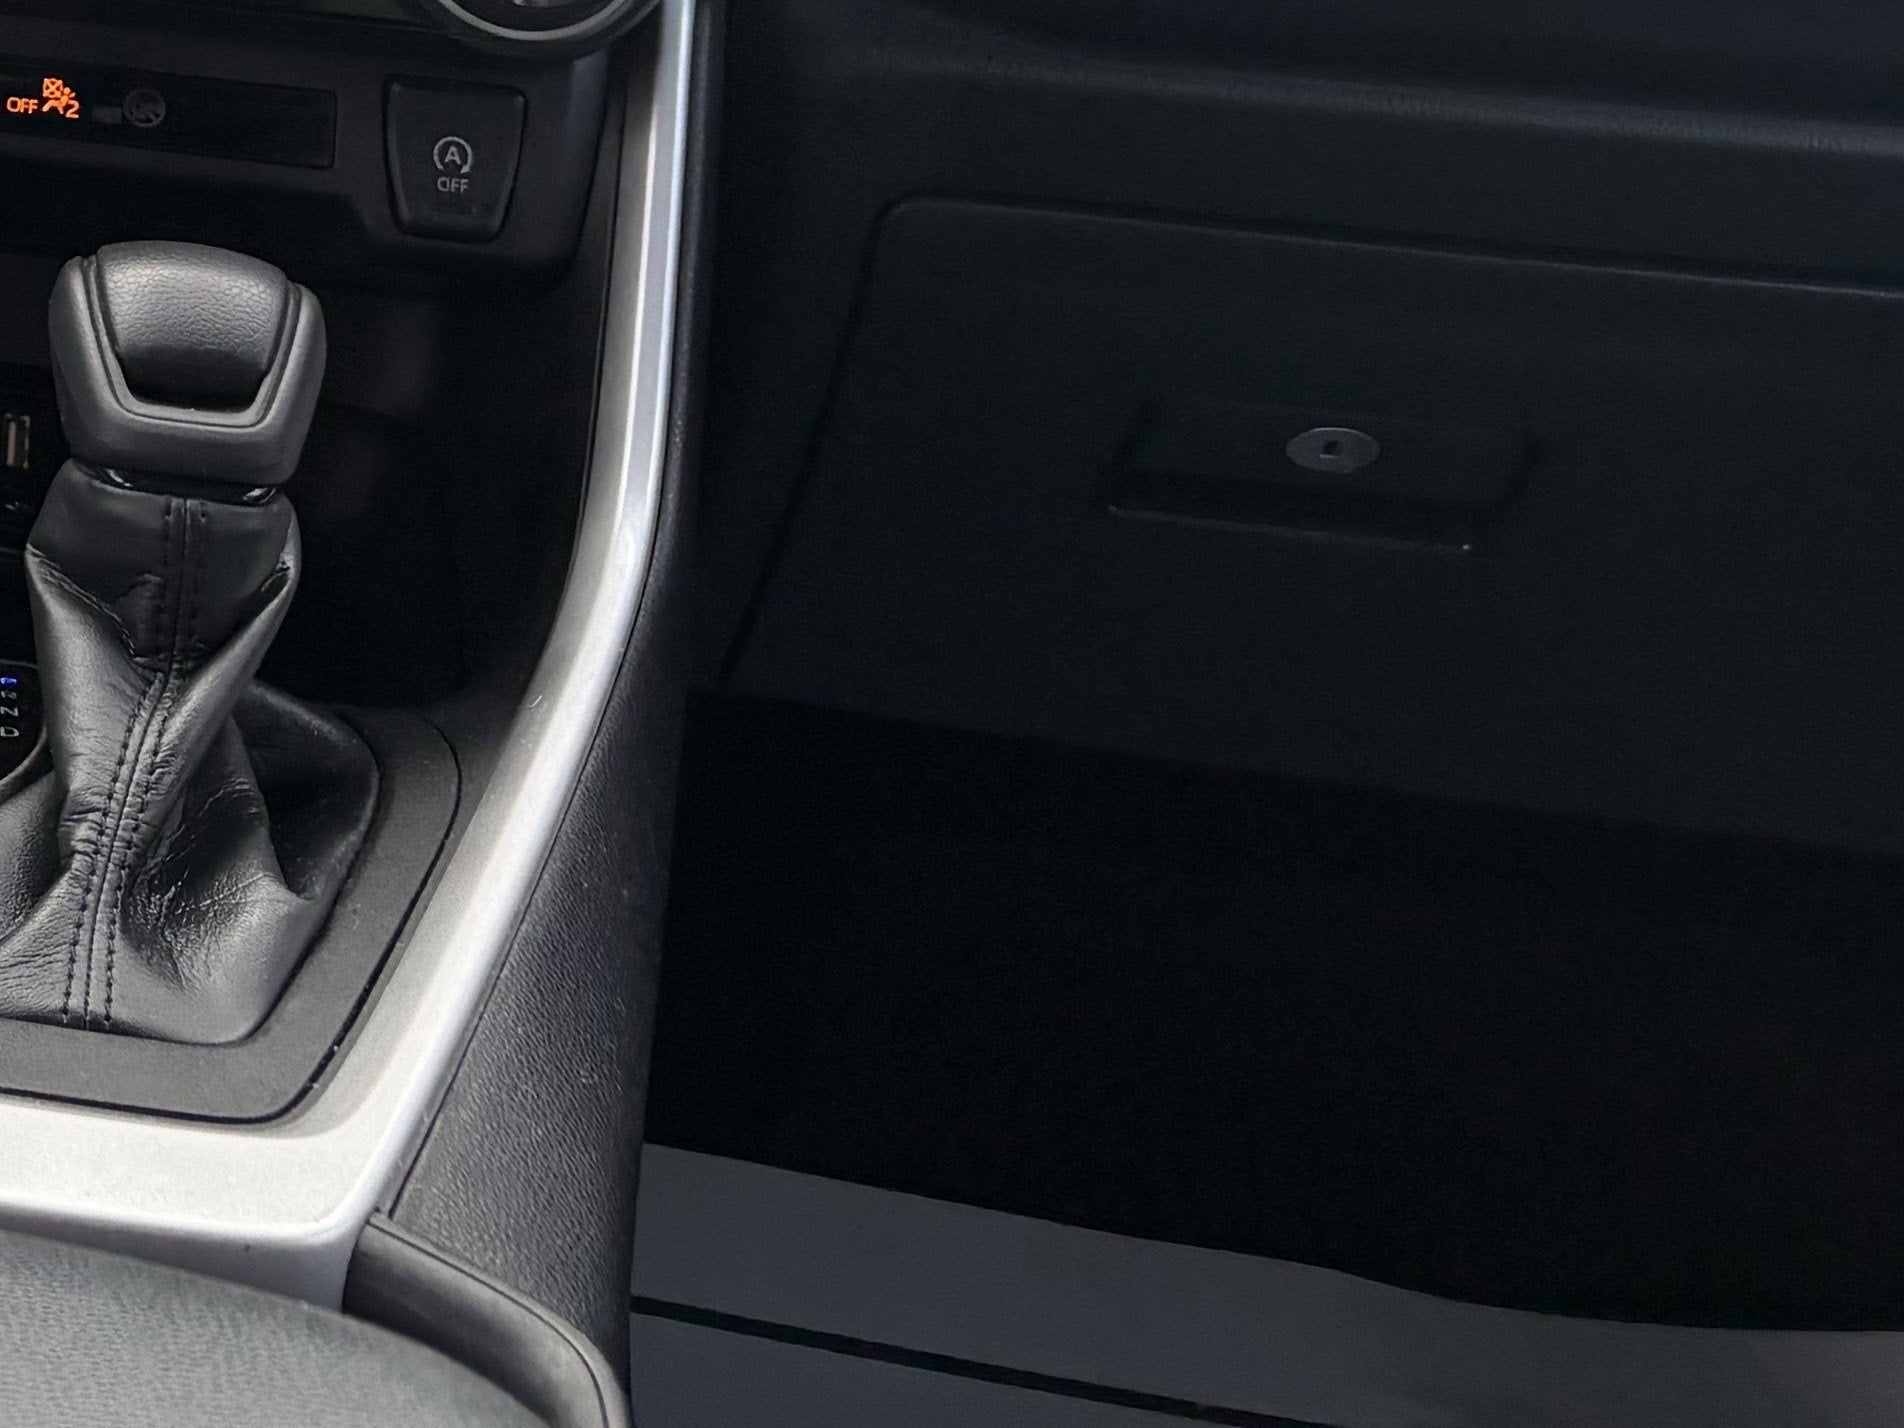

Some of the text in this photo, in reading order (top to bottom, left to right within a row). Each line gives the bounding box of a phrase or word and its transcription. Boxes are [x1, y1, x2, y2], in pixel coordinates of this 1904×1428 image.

[6, 96, 39, 116] OFF
[436, 176, 470, 194] OFF
[0, 706, 19, 717] N
[0, 725, 20, 738] D
